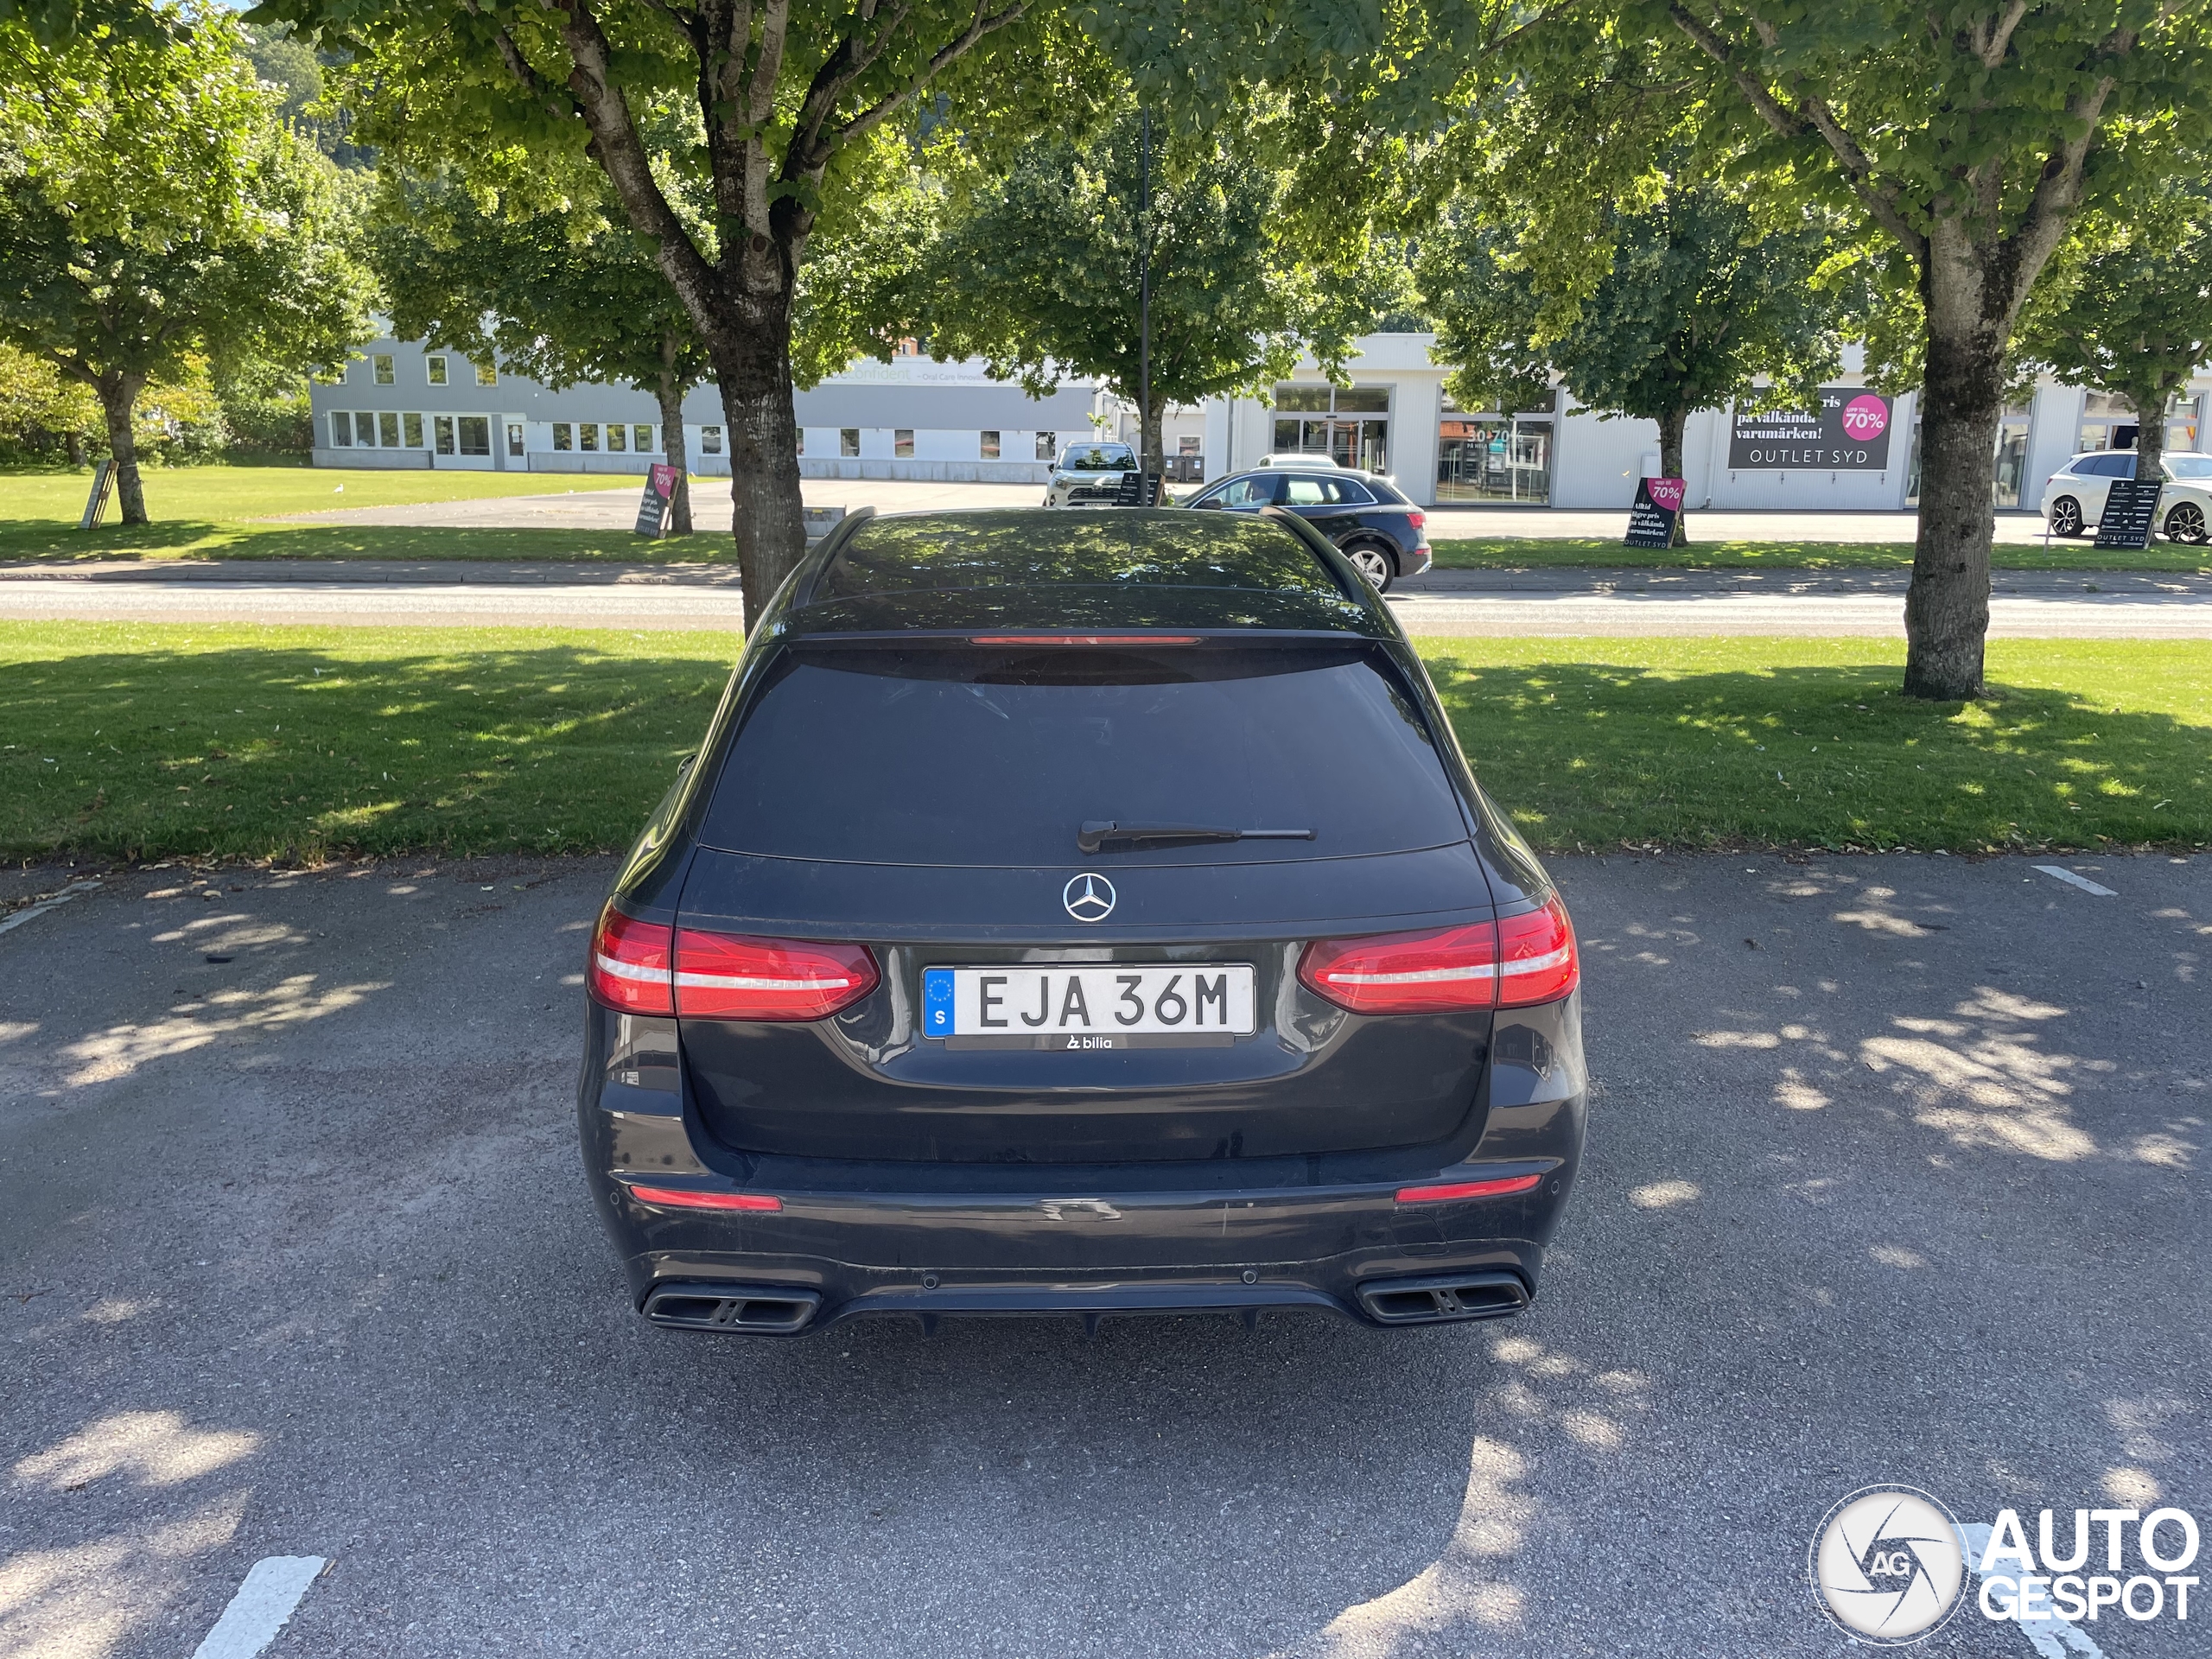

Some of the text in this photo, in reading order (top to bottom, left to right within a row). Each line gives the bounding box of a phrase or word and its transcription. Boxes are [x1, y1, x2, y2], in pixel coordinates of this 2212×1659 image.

[1821, 395, 1841, 408] ris
[1845, 413, 1885, 429] 70%
[1736, 426, 1823, 440] varumärken!
[1750, 449, 1867, 464] OUTLET SYD
[655, 472, 671, 487] 70%
[1653, 486, 1680, 499] 70%
[980, 975, 1227, 1027] EJA 36M
[934, 1010, 946, 1025] S
[1083, 1036, 1113, 1050] bilia
